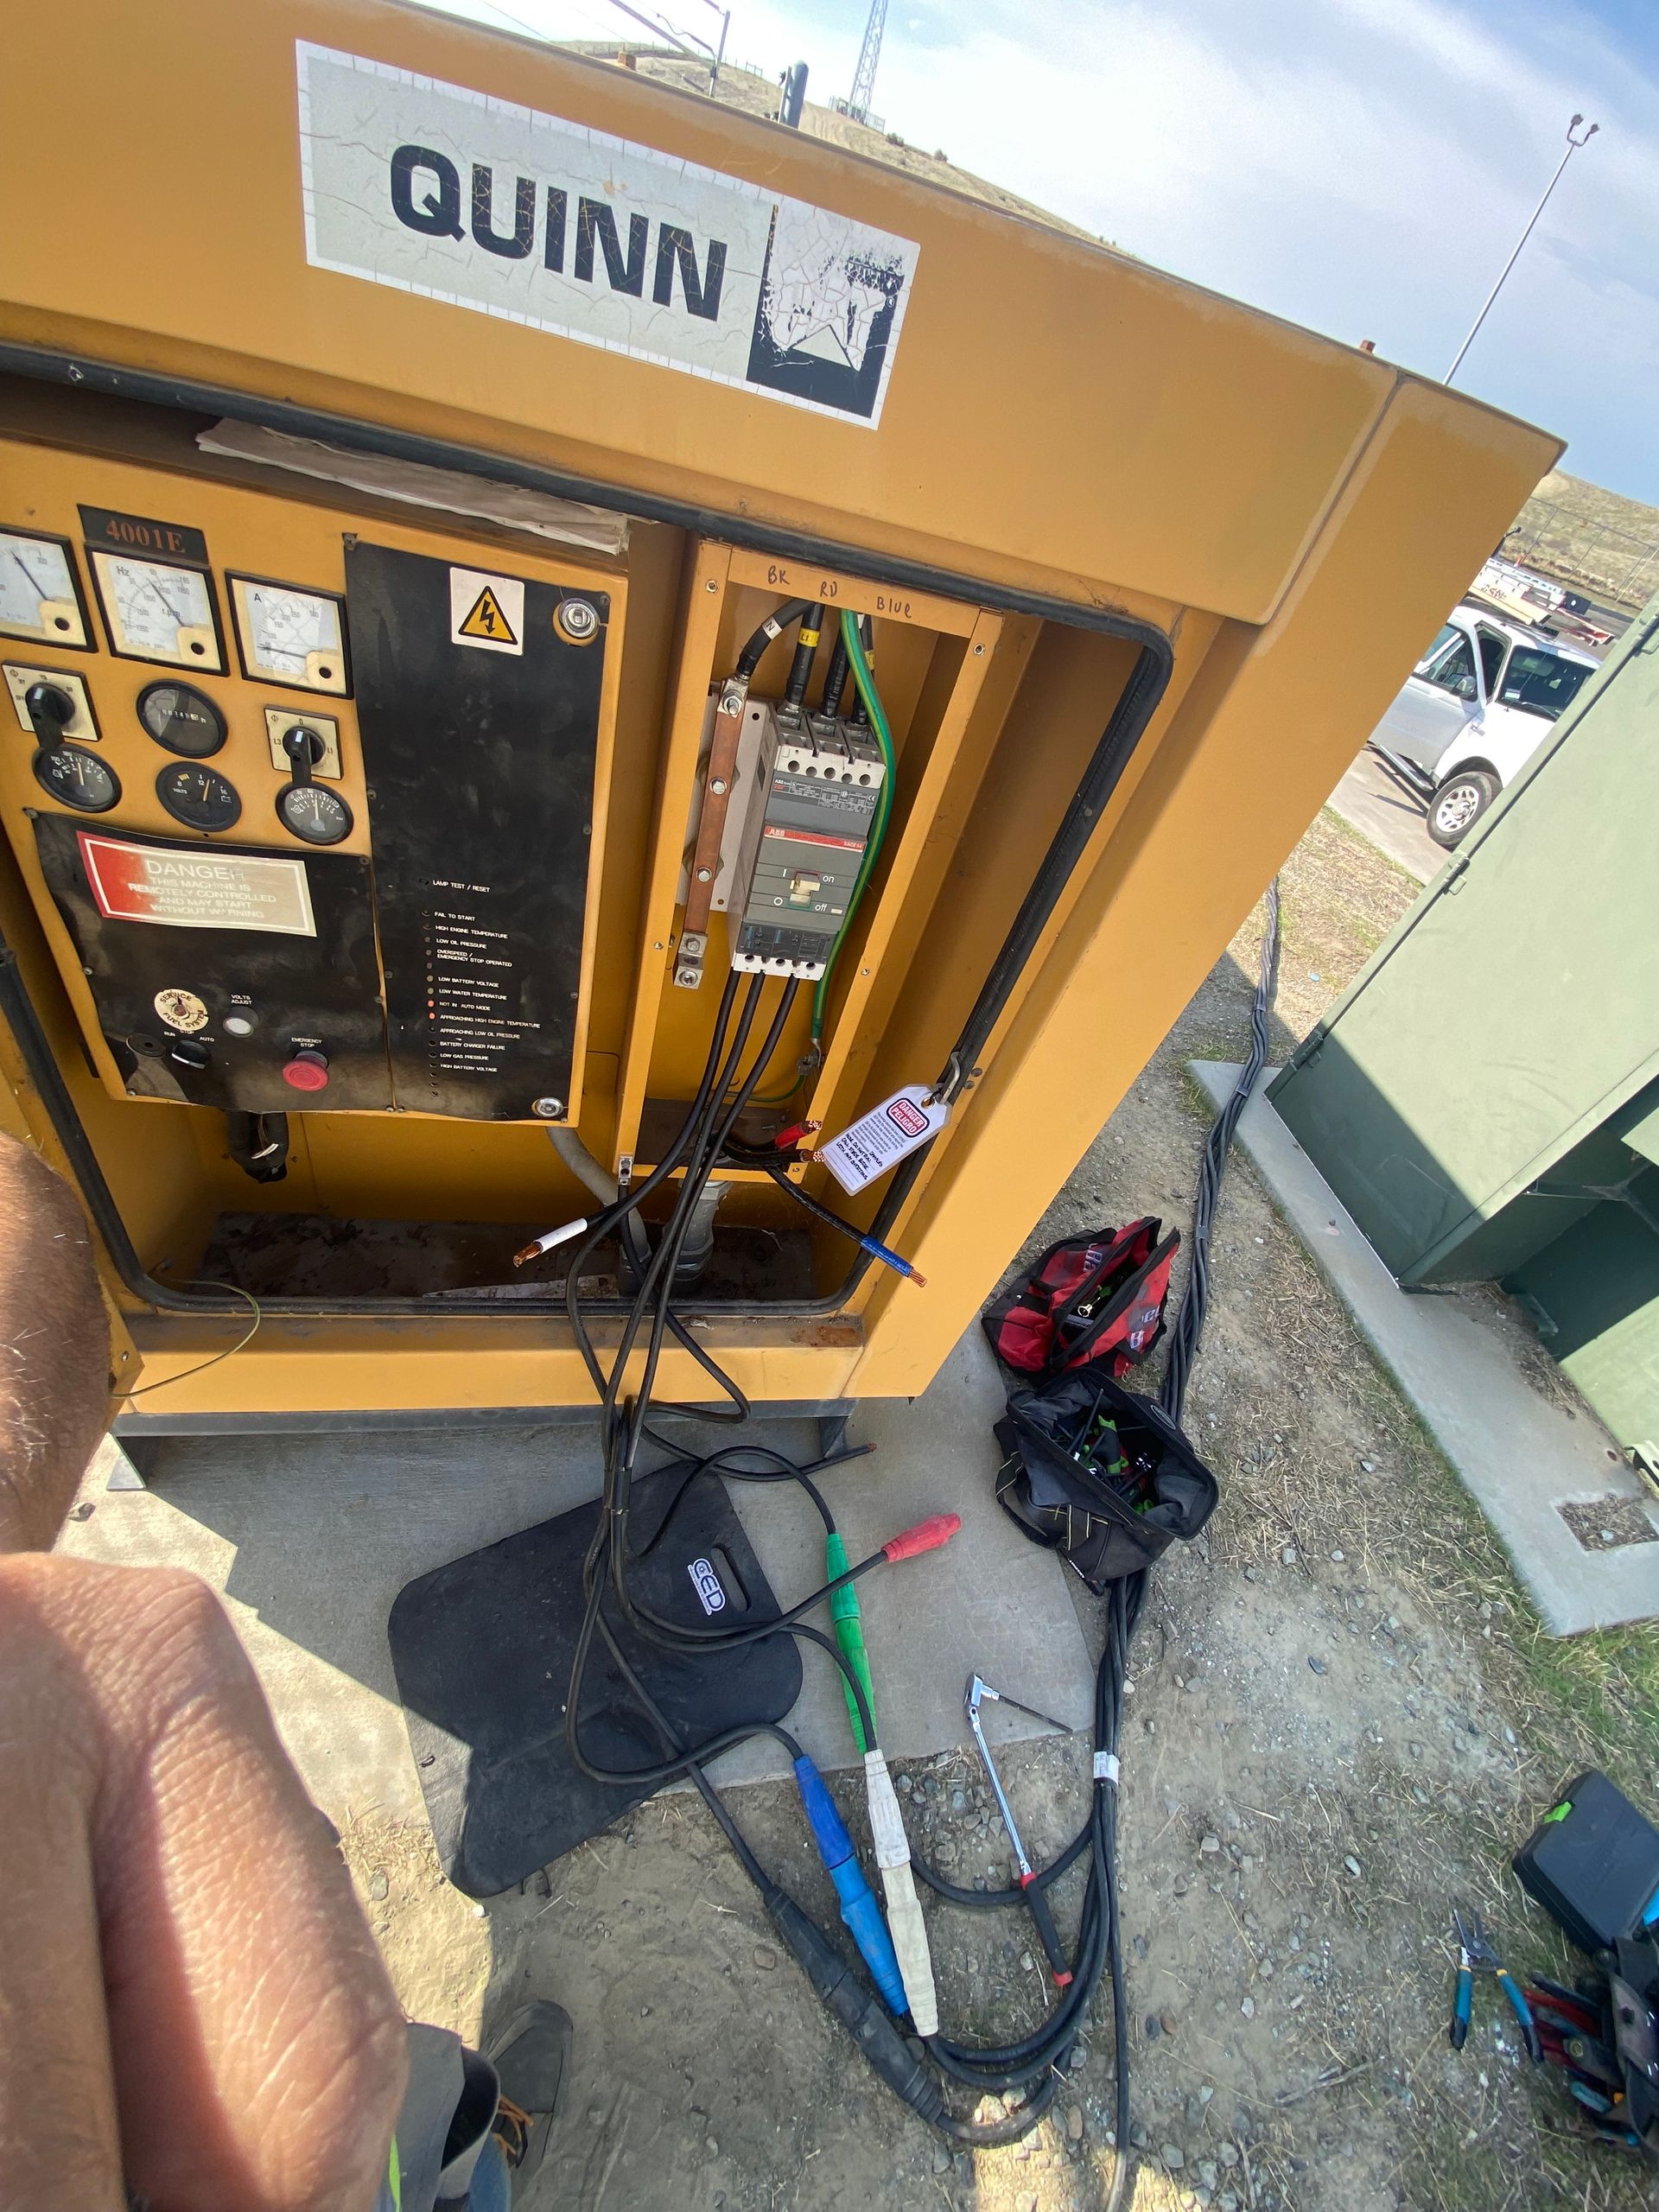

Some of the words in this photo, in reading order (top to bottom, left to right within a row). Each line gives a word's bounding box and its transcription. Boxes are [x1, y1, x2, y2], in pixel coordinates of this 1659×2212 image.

[390, 143, 728, 322] QUINN
[105, 519, 186, 553] 4001E
[116, 566, 130, 577] Hz
[767, 565, 791, 585] BK
[820, 581, 838, 597] RD
[254, 593, 263, 603] A
[766, 620, 775, 631] N
[800, 632, 810, 642] L1
[149, 876, 179, 888] THIS
[181, 879, 236, 892] MACHINE
[128, 882, 193, 897] REMOTELY
[196, 889, 276, 903] CONTROLLED
[158, 896, 184, 906] AND
[186, 898, 211, 907] MAY
[214, 899, 252, 910] START
[815, 903, 828, 912] off
[149, 904, 206, 916] WITHOUT
[470, 929, 508, 939] TEMPERATURE
[460, 941, 487, 950] PRESSURE
[437, 953, 468, 962] EMERGENCY
[159, 991, 192, 1003] SERVICE
[472, 992, 507, 1001] TEMPERATURE
[162, 1012, 182, 1027] FUEL
[185, 1009, 206, 1028] SYSTEM
[891, 1107, 918, 1133] PELIGRO
[898, 1102, 924, 1128] DANGER
